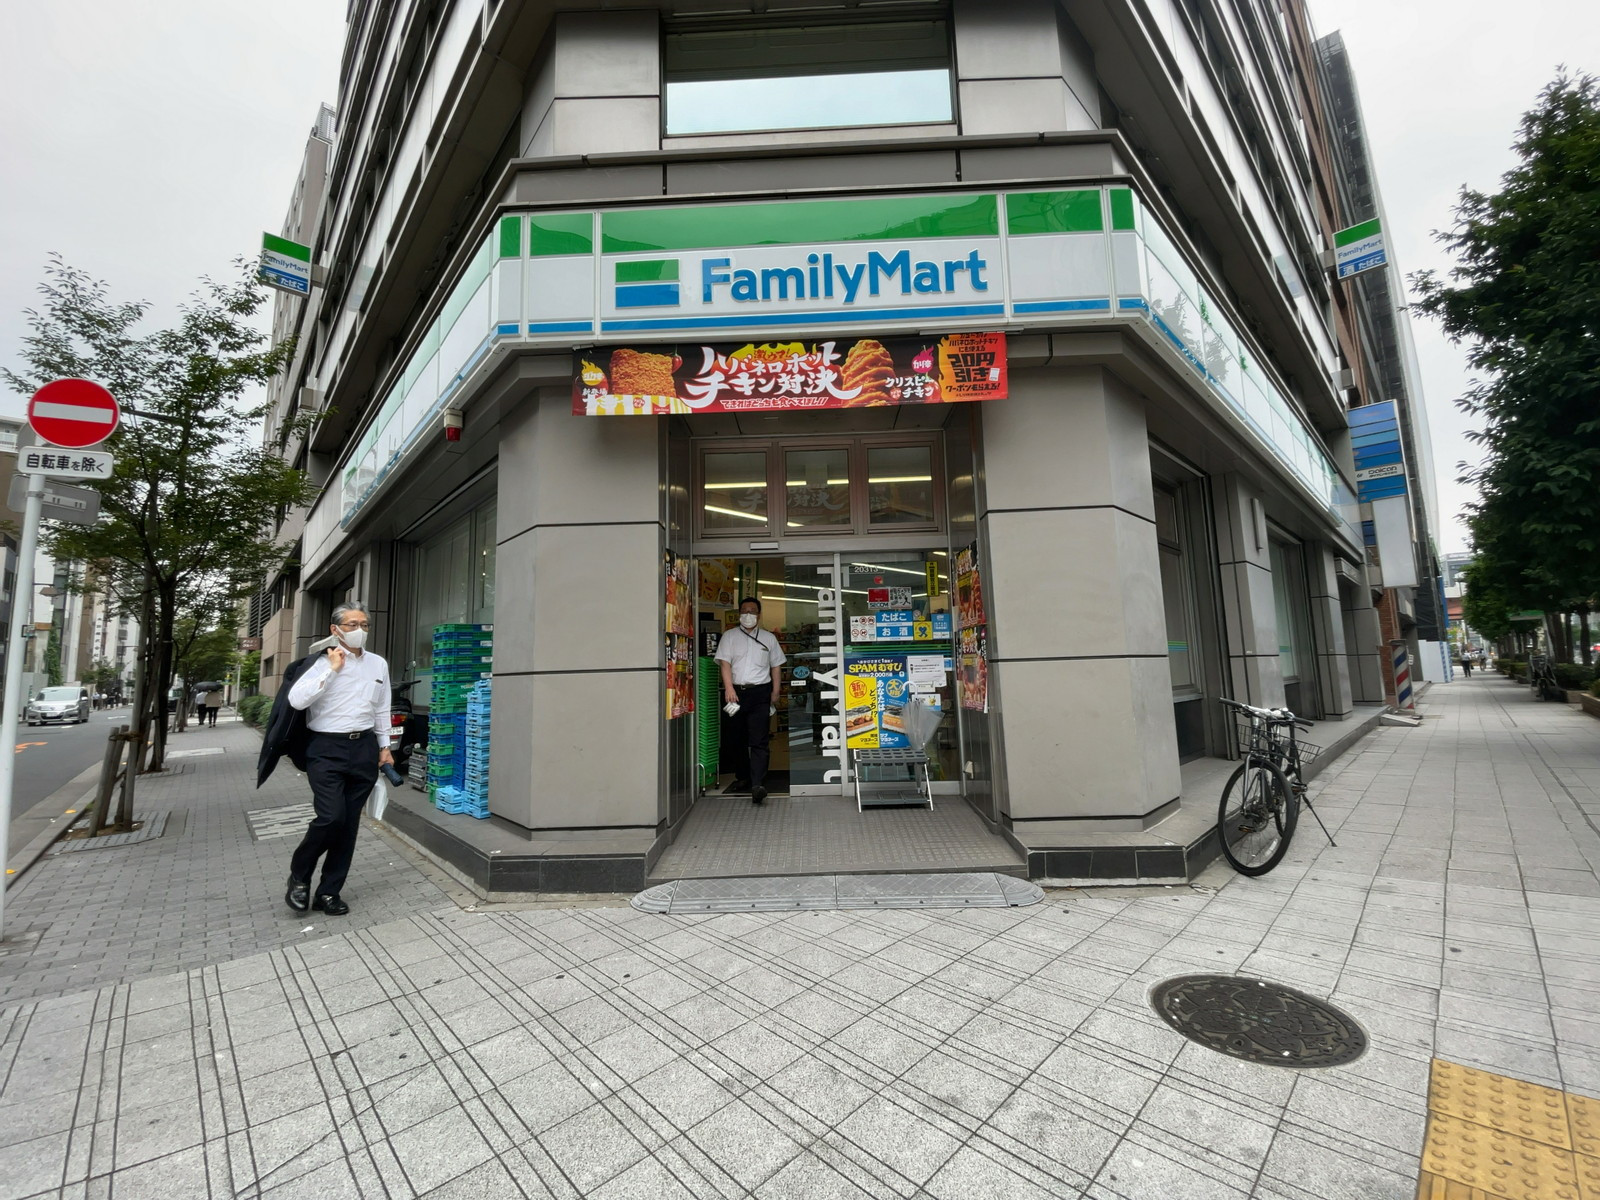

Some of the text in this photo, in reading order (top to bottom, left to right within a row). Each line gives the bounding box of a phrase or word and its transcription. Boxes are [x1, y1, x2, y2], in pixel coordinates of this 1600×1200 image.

[1338, 239, 1382, 259] FamilyMart
[263, 253, 308, 273] FamilyMart
[1358, 256, 1382, 270] たばこ
[280, 277, 304, 291] たばこ
[702, 249, 988, 304] FamilyMart
[946, 352, 996, 367] 20円
[885, 376, 934, 388] クリスピー
[952, 367, 990, 382] 引き
[679, 366, 863, 409] チキン対決
[902, 387, 934, 398] チキン
[26, 453, 105, 473] 自転車を除く
[881, 613, 907, 622] たばこ
